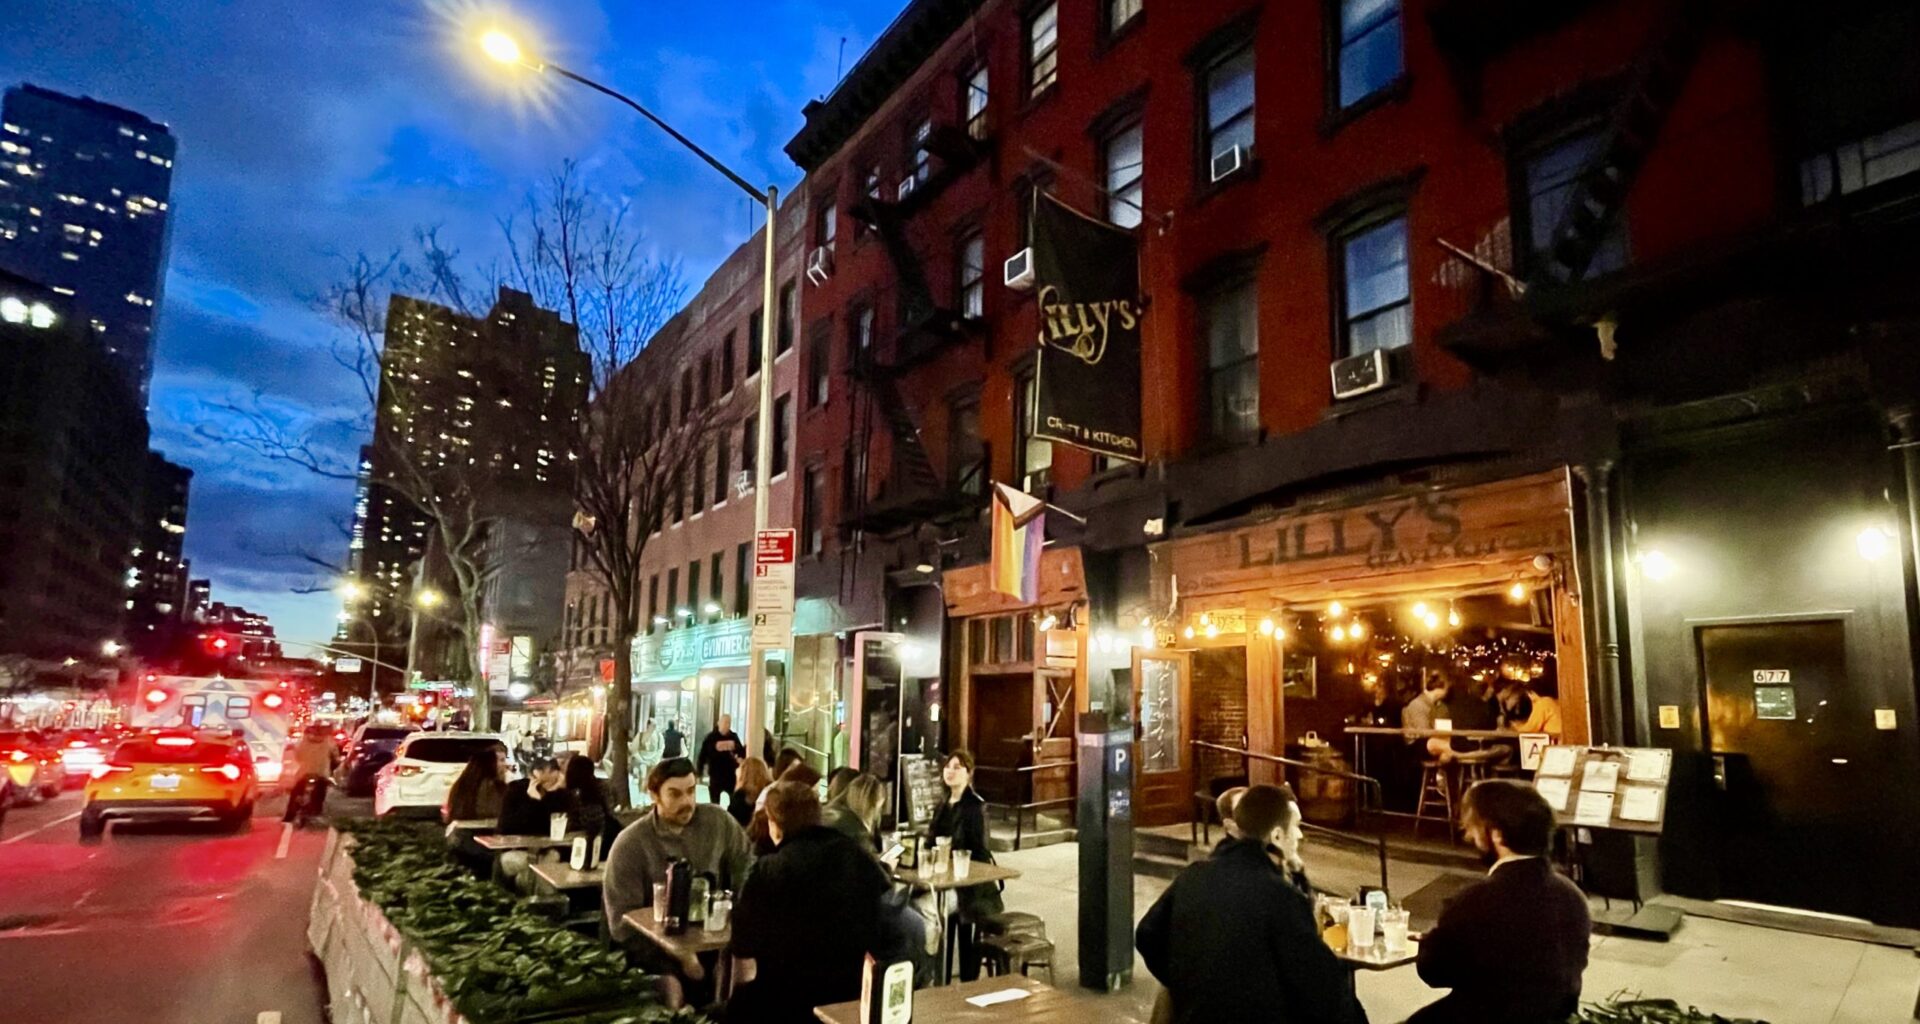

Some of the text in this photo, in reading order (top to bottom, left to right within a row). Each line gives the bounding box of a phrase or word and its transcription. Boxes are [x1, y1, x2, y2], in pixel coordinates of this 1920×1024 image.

[760, 565, 766, 577] 3
[758, 614, 765, 625] 2
[1756, 671, 1787, 681] 677
[1528, 742, 1541, 759] A
[1115, 748, 1126, 772] P
